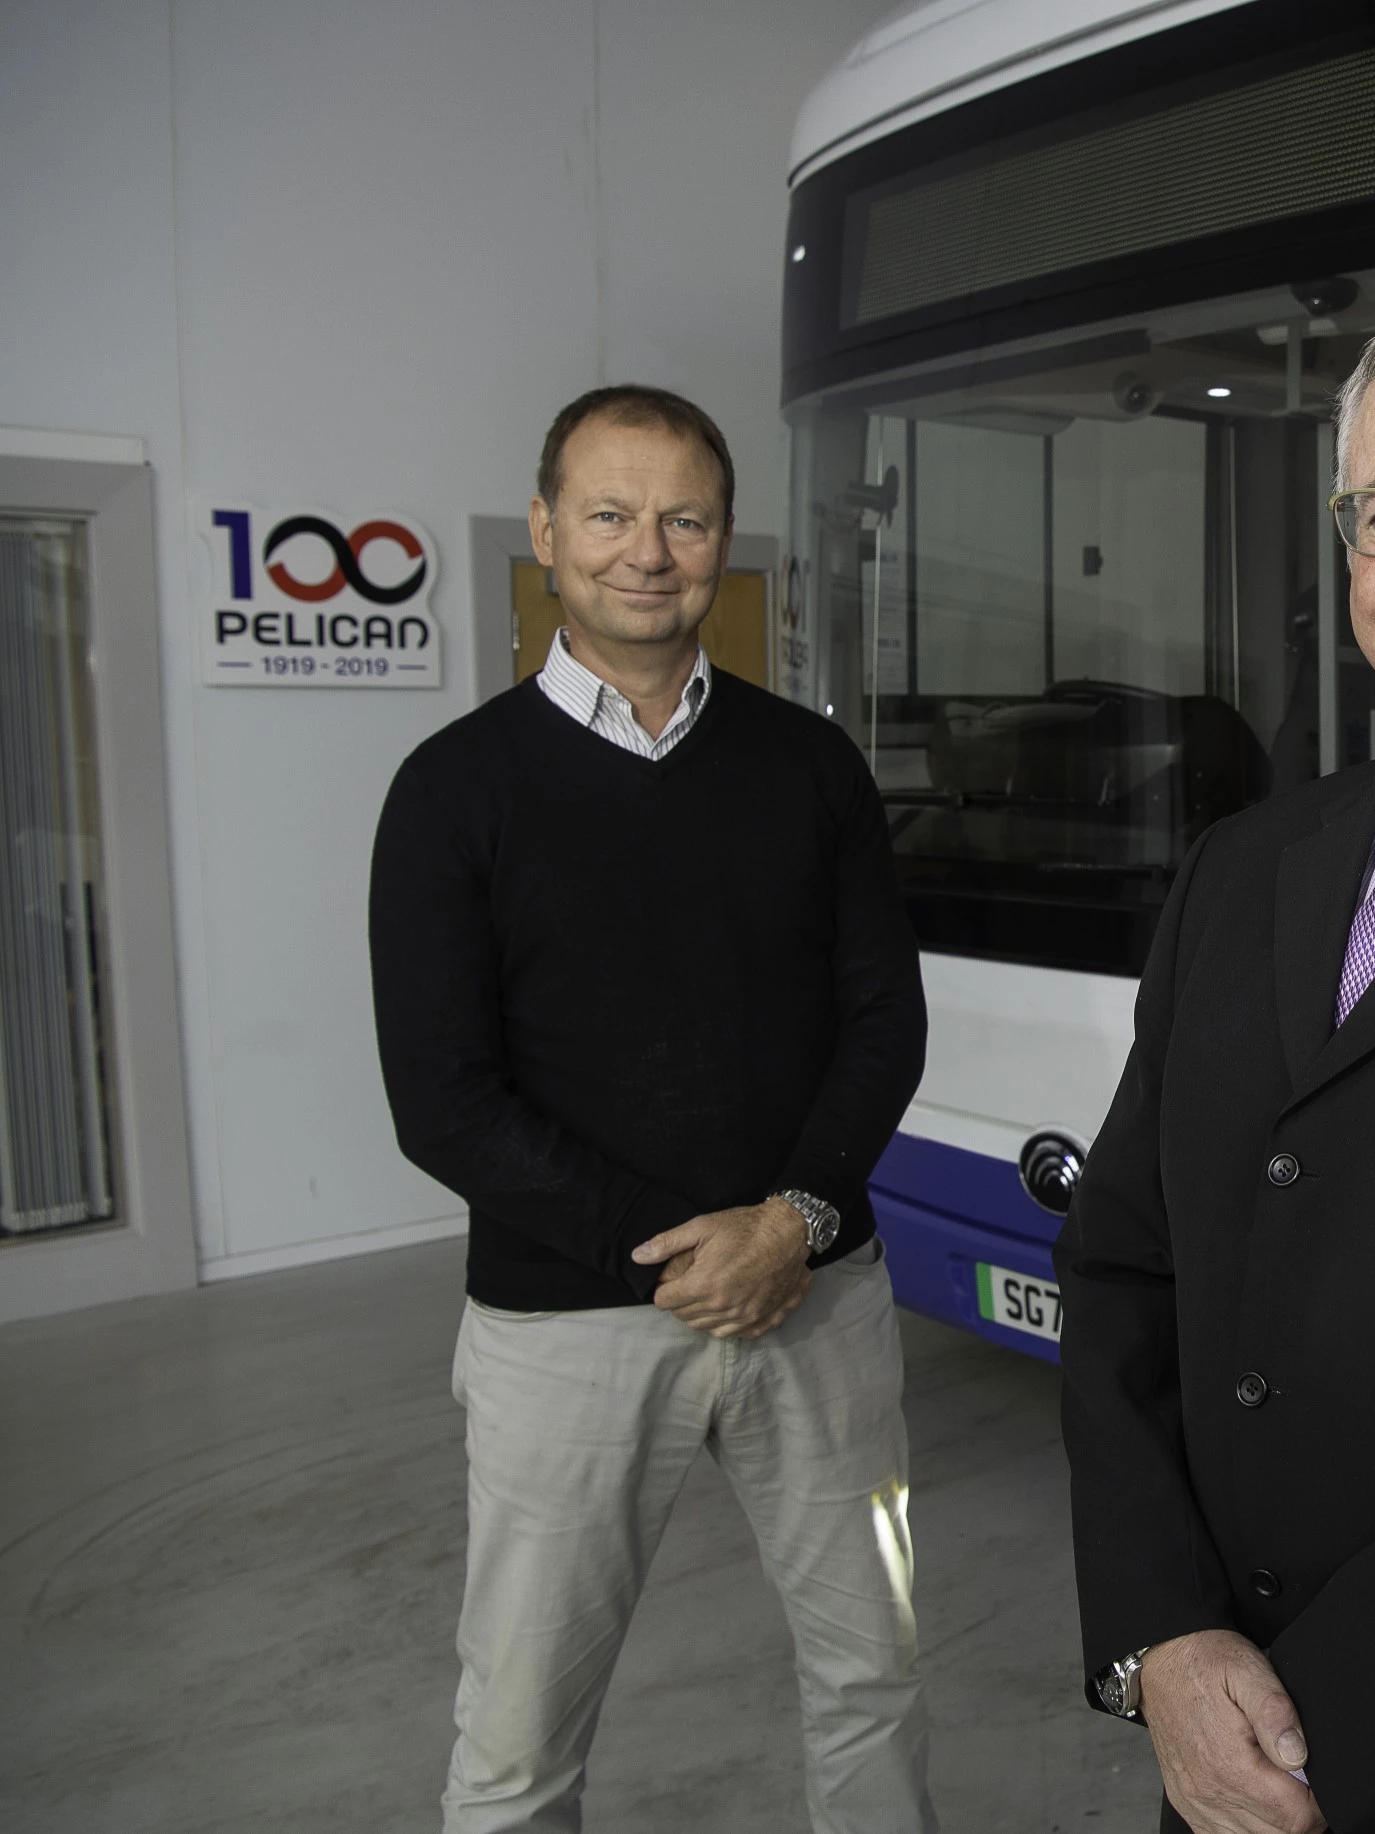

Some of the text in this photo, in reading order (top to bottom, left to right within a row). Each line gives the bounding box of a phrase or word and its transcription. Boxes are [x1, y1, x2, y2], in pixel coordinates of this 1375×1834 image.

[212, 510, 427, 606] 100
[216, 611, 429, 649] PELICAN
[262, 656, 316, 675] 1919
[335, 657, 389, 676] 2019
